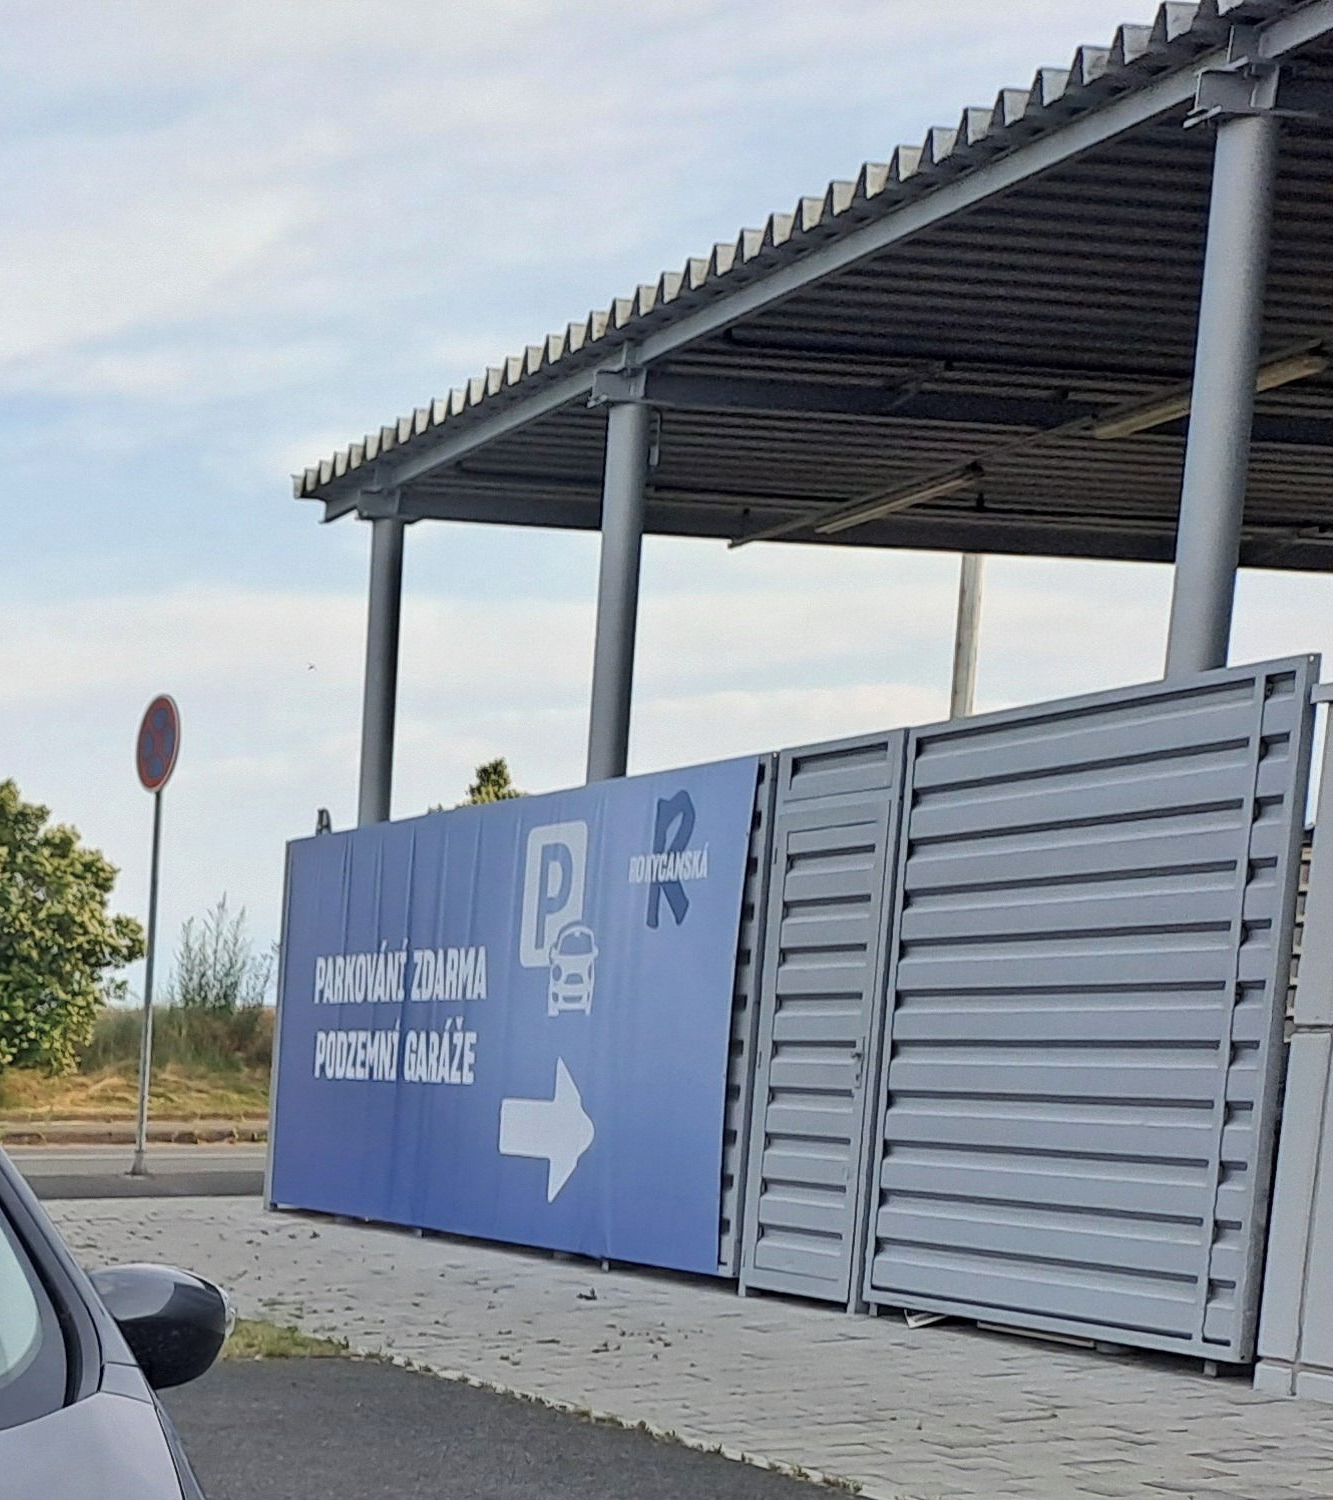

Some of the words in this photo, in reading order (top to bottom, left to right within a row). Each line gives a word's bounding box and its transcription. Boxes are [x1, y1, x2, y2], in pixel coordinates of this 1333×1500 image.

[535, 842, 575, 951] P
[314, 937, 409, 1005] PARKOVÁNÍ
[410, 945, 488, 1002] ZDARMA
[314, 1017, 401, 1081] PODZEMNÍ
[403, 1015, 477, 1085] GARÁŽE
